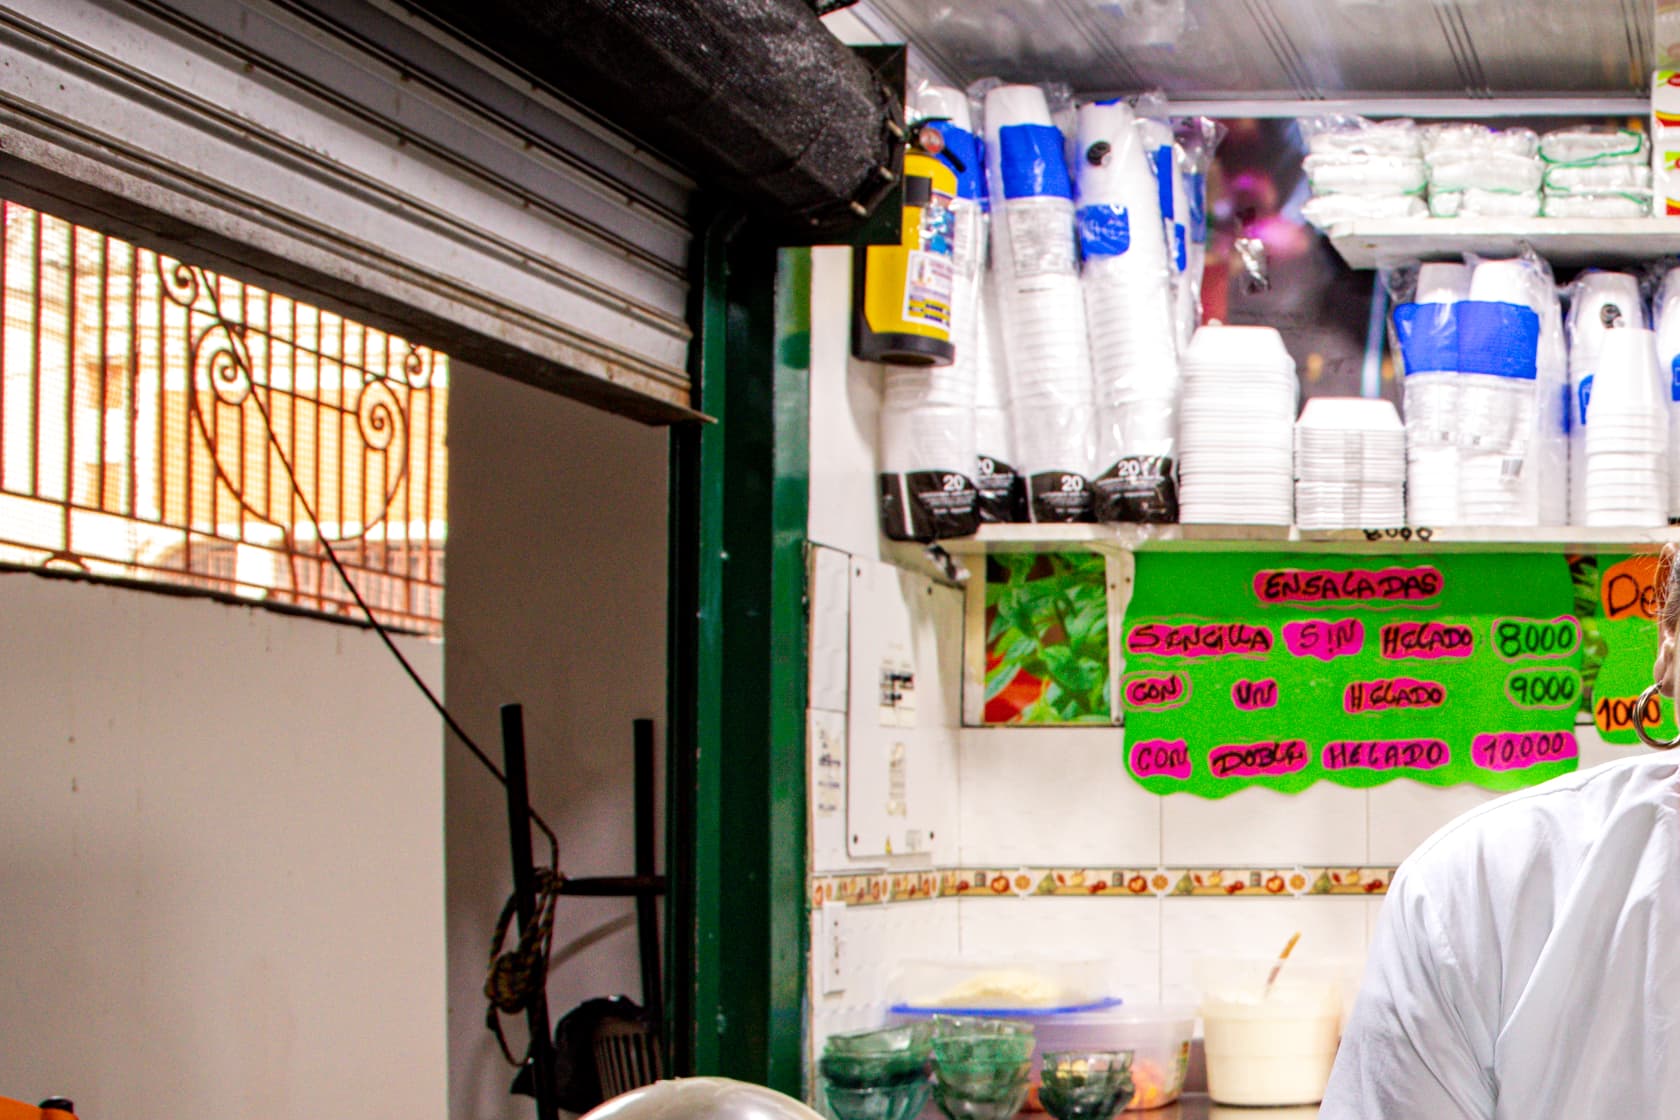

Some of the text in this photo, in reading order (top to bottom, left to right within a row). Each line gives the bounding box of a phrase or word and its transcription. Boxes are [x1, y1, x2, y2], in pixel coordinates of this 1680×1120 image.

[1118, 460, 1139, 476] 20
[943, 474, 965, 492] 20
[1061, 475, 1084, 492] 20
[1263, 570, 1438, 600] ENSALADAS
[1131, 674, 1178, 701] CON
[1236, 680, 1277, 705] UN
[1137, 745, 1189, 771] CON
[1212, 739, 1304, 774] DOBLE
[1329, 741, 1443, 767] HELADO
